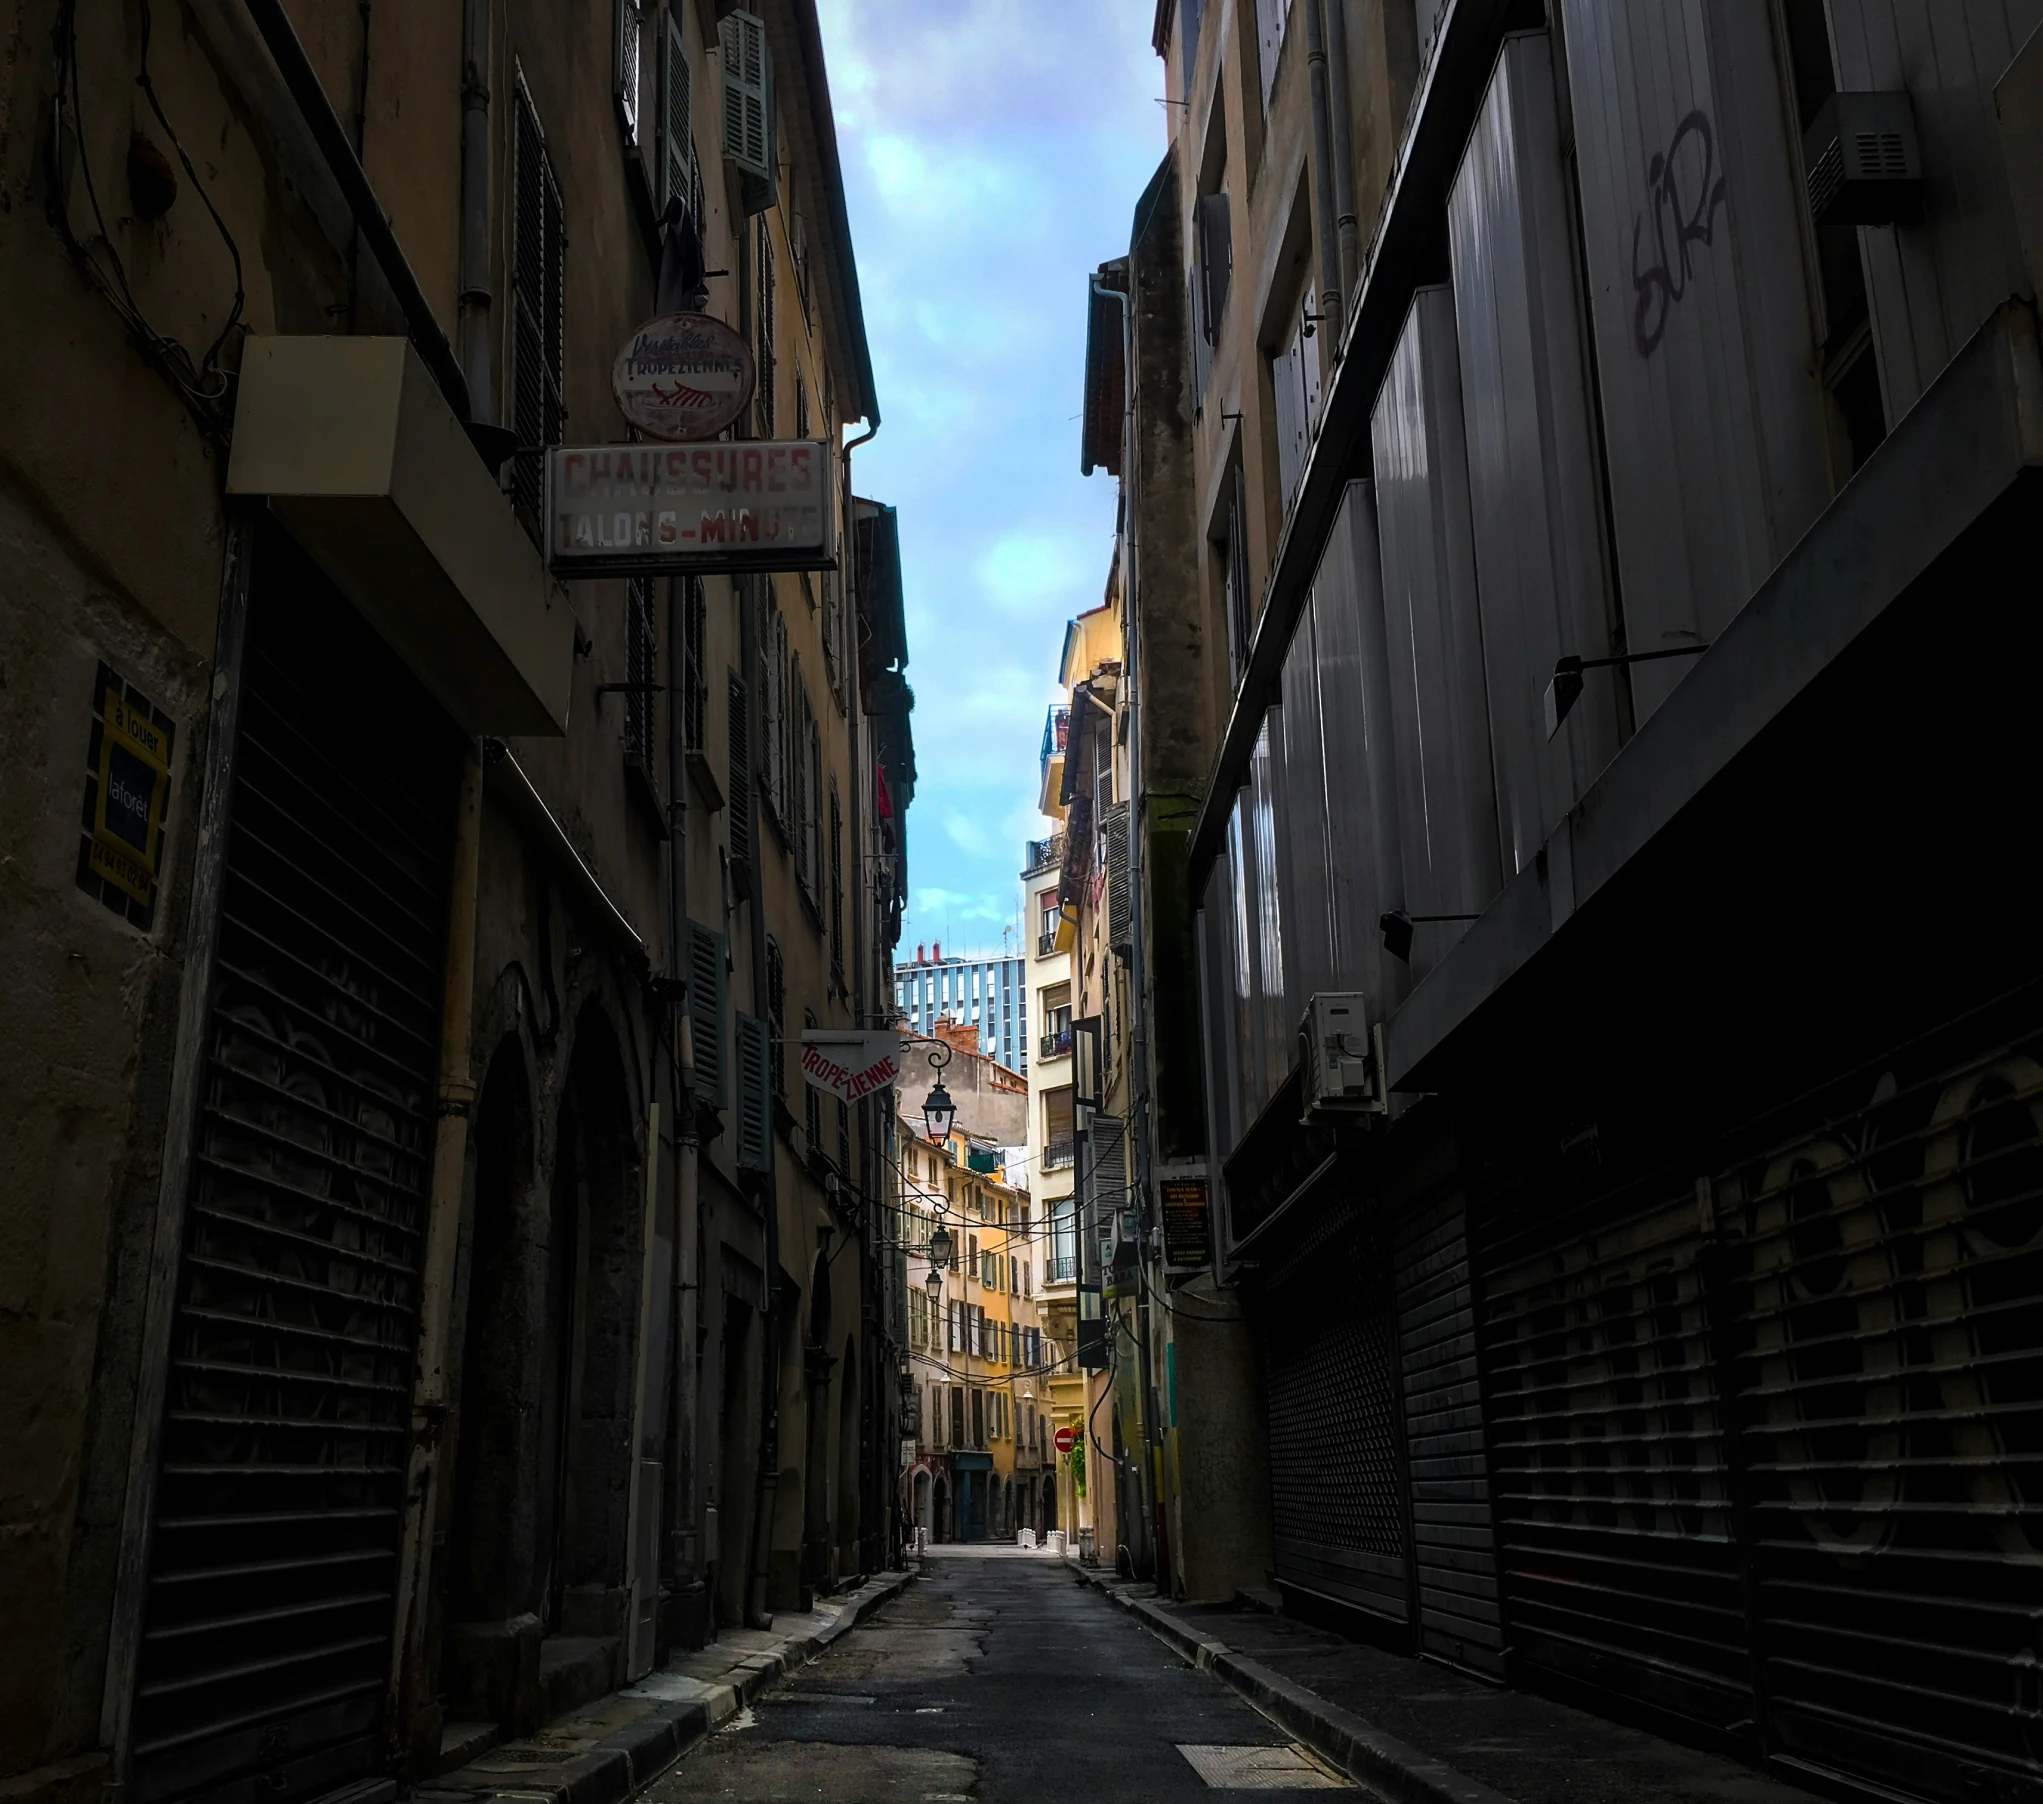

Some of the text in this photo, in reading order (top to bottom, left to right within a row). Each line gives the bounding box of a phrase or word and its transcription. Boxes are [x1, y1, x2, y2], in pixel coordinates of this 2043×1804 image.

[564, 448, 813, 499] CHAUSSURES
[560, 505, 820, 548] TALONS-MINUTE
[115, 700, 160, 753] à louer
[108, 771, 149, 822] laforêt
[93, 842, 103, 863] 04
[104, 850, 115, 870] 94
[116, 858, 126, 878] 93
[127, 866, 138, 887] 02
